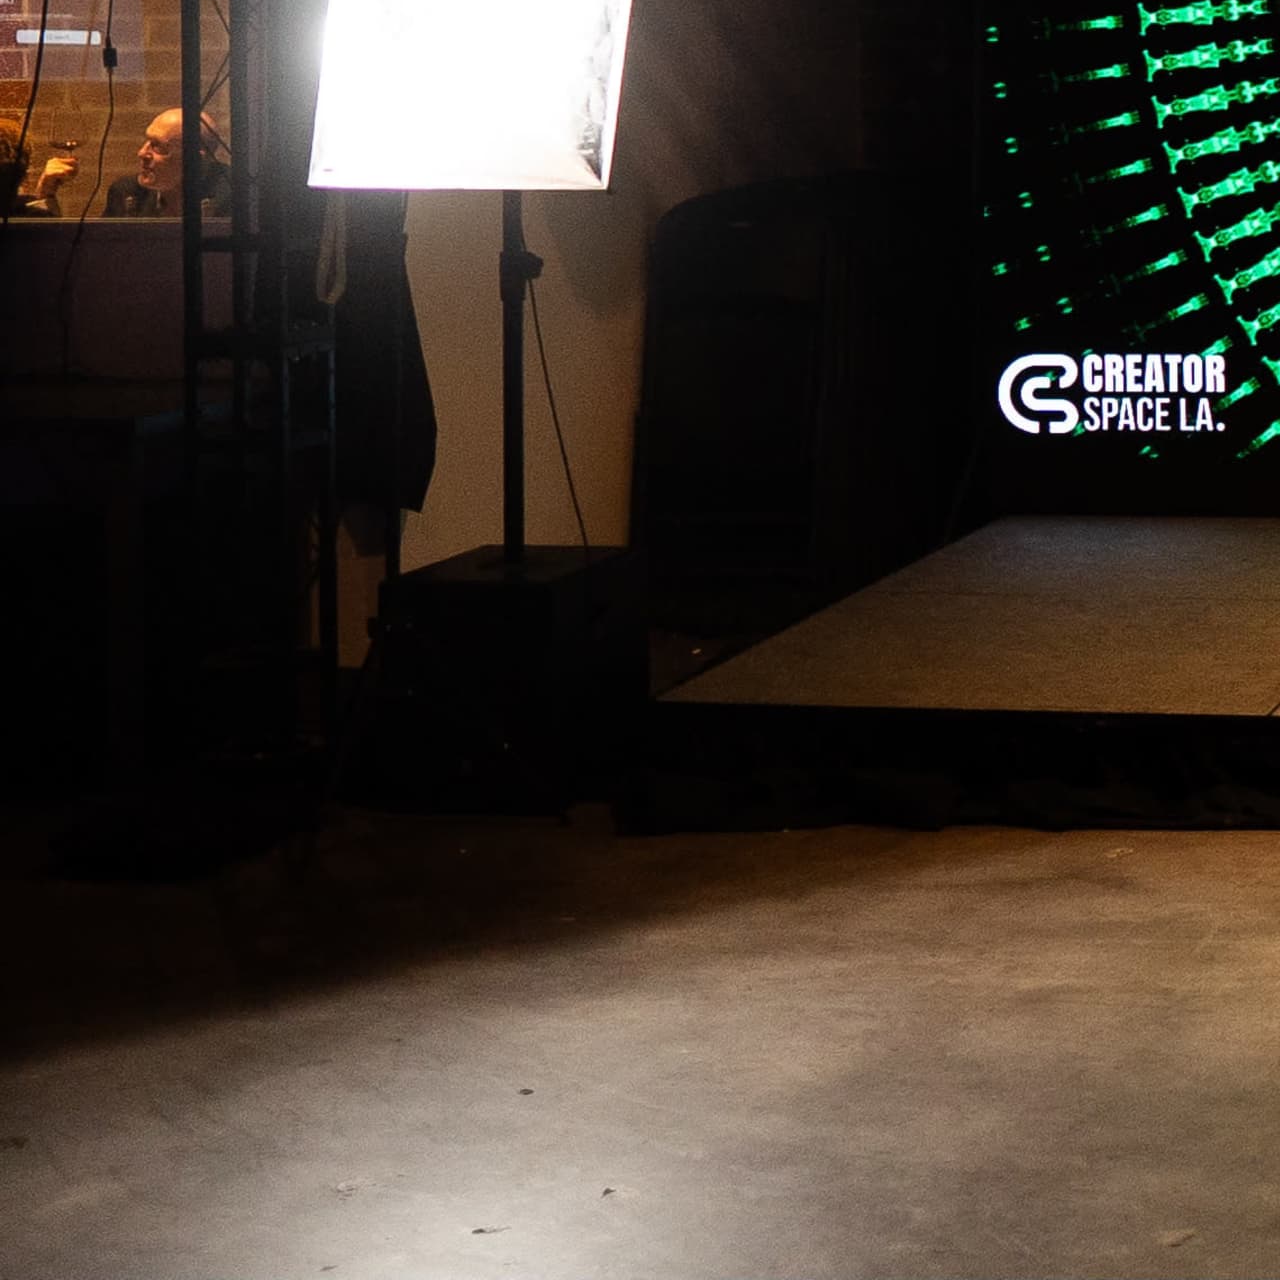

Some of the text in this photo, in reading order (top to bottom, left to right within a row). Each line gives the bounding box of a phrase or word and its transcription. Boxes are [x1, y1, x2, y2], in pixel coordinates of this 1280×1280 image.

[1082, 354, 1226, 393] CREATOR
[1083, 396, 1226, 432] SPACE LA.
